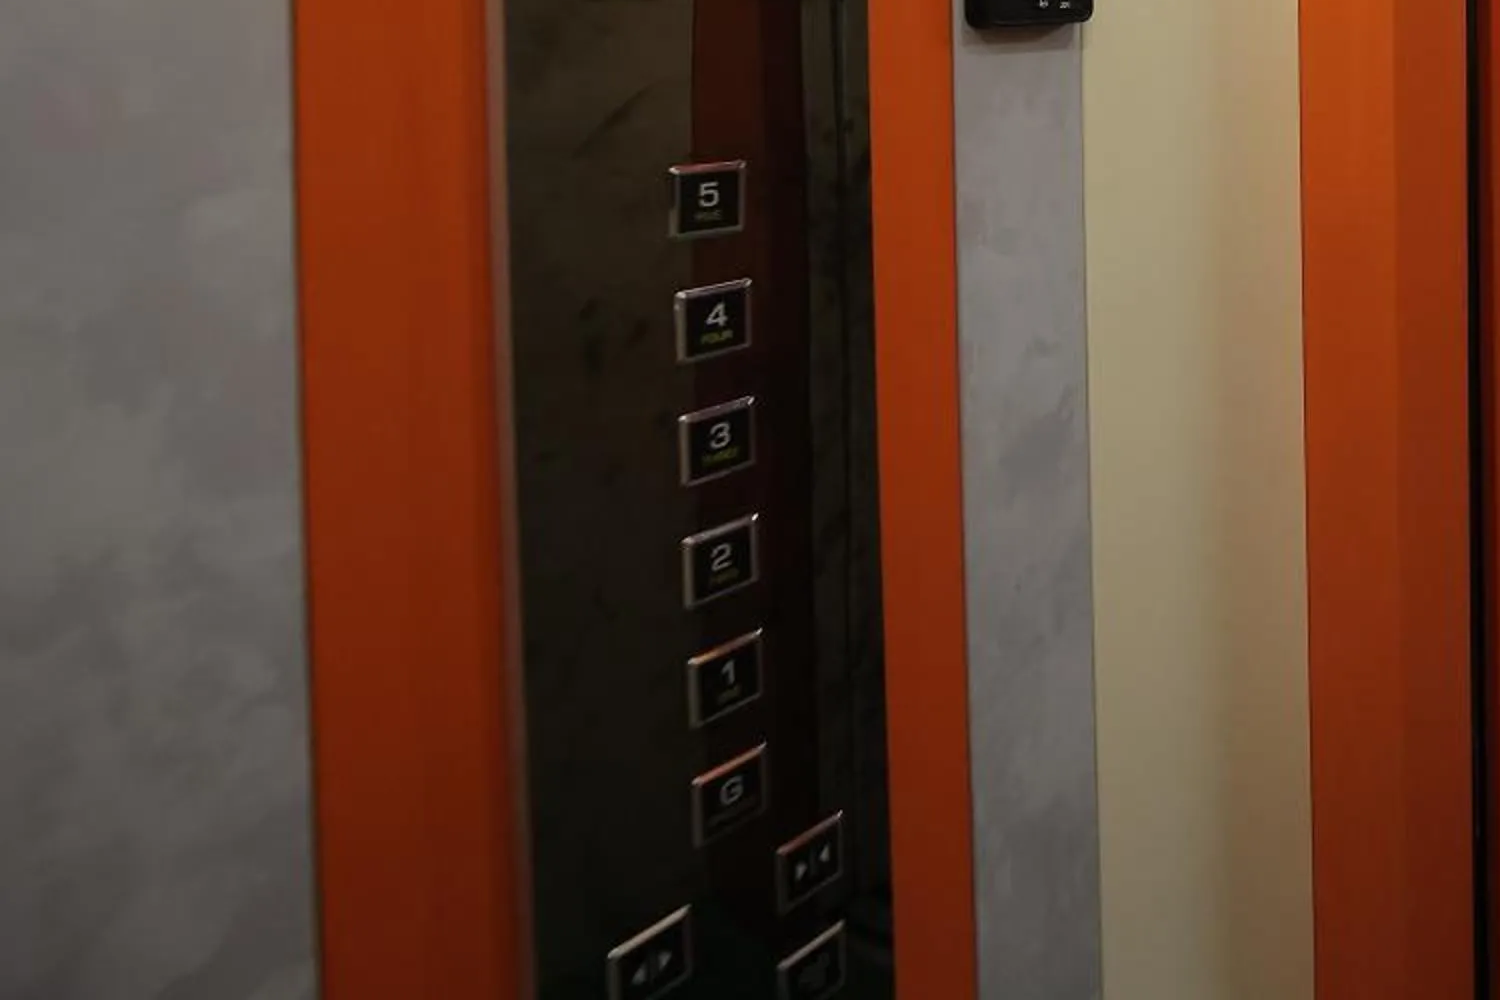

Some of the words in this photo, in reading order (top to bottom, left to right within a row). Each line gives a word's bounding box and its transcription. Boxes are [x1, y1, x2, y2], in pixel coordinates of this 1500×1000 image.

[699, 181, 720, 207] 5
[705, 302, 729, 327] 4
[709, 421, 731, 449] 3
[710, 542, 733, 571] 2
[720, 659, 736, 686] 1
[720, 774, 744, 805] G
